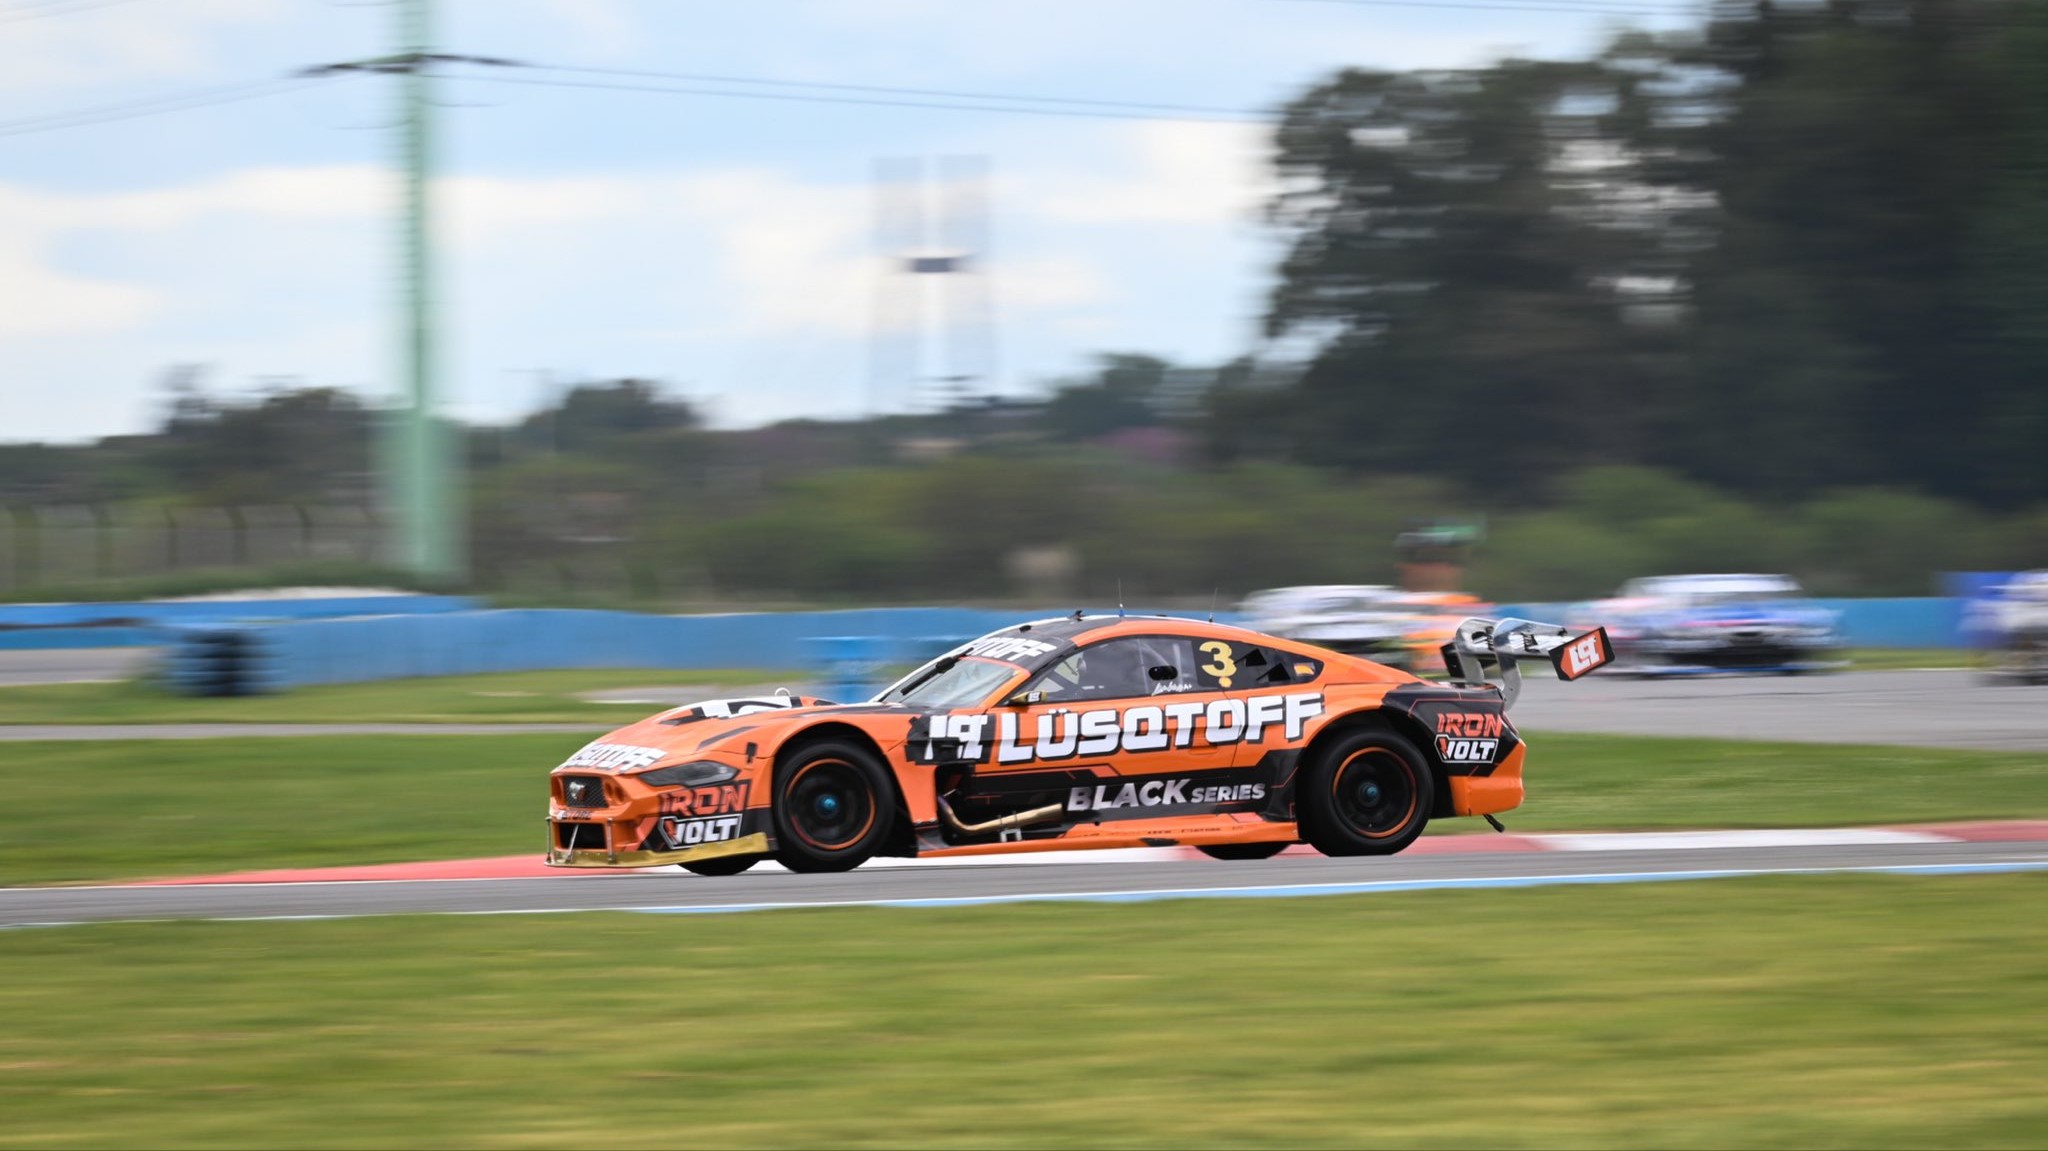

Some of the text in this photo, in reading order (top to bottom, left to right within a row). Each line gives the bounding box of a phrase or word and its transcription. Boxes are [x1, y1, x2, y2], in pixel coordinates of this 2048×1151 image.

[1199, 641, 1238, 677] 3
[998, 693, 1323, 762] LÜSQTOFF
[1437, 713, 1503, 737] IRON
[1439, 737, 1496, 760] VOLT
[660, 783, 749, 816] IRON
[1066, 778, 1266, 812] BLACK SERIES
[664, 817, 739, 845] VOLT
